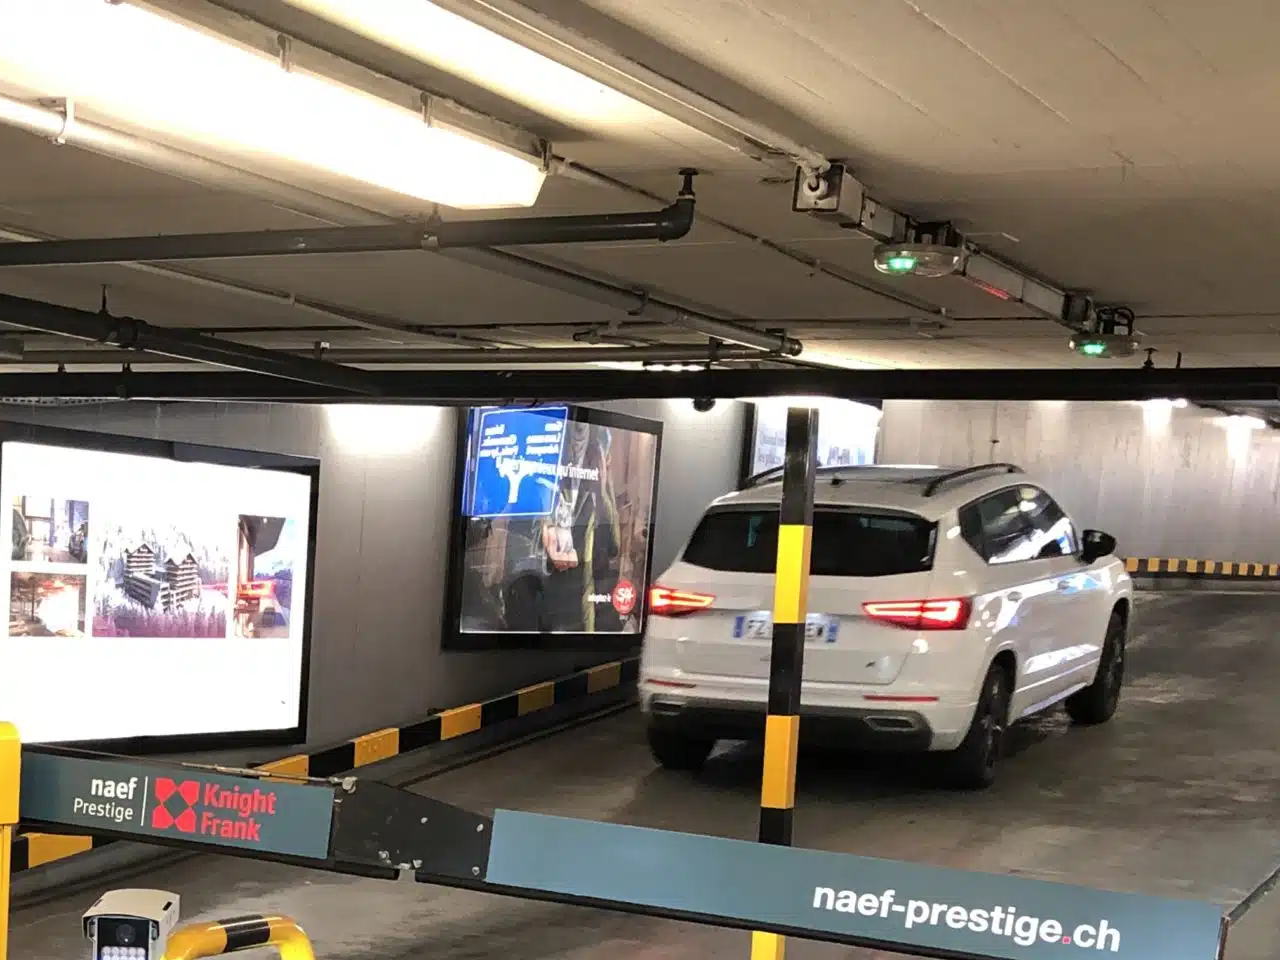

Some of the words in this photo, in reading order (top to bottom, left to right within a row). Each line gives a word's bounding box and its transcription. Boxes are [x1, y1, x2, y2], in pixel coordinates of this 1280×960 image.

[90, 776, 138, 800] naef
[204, 783, 277, 818] Knight
[73, 798, 134, 823] Prestige
[200, 812, 262, 842] Frank
[812, 885, 1122, 952] naef-prestige.ch
